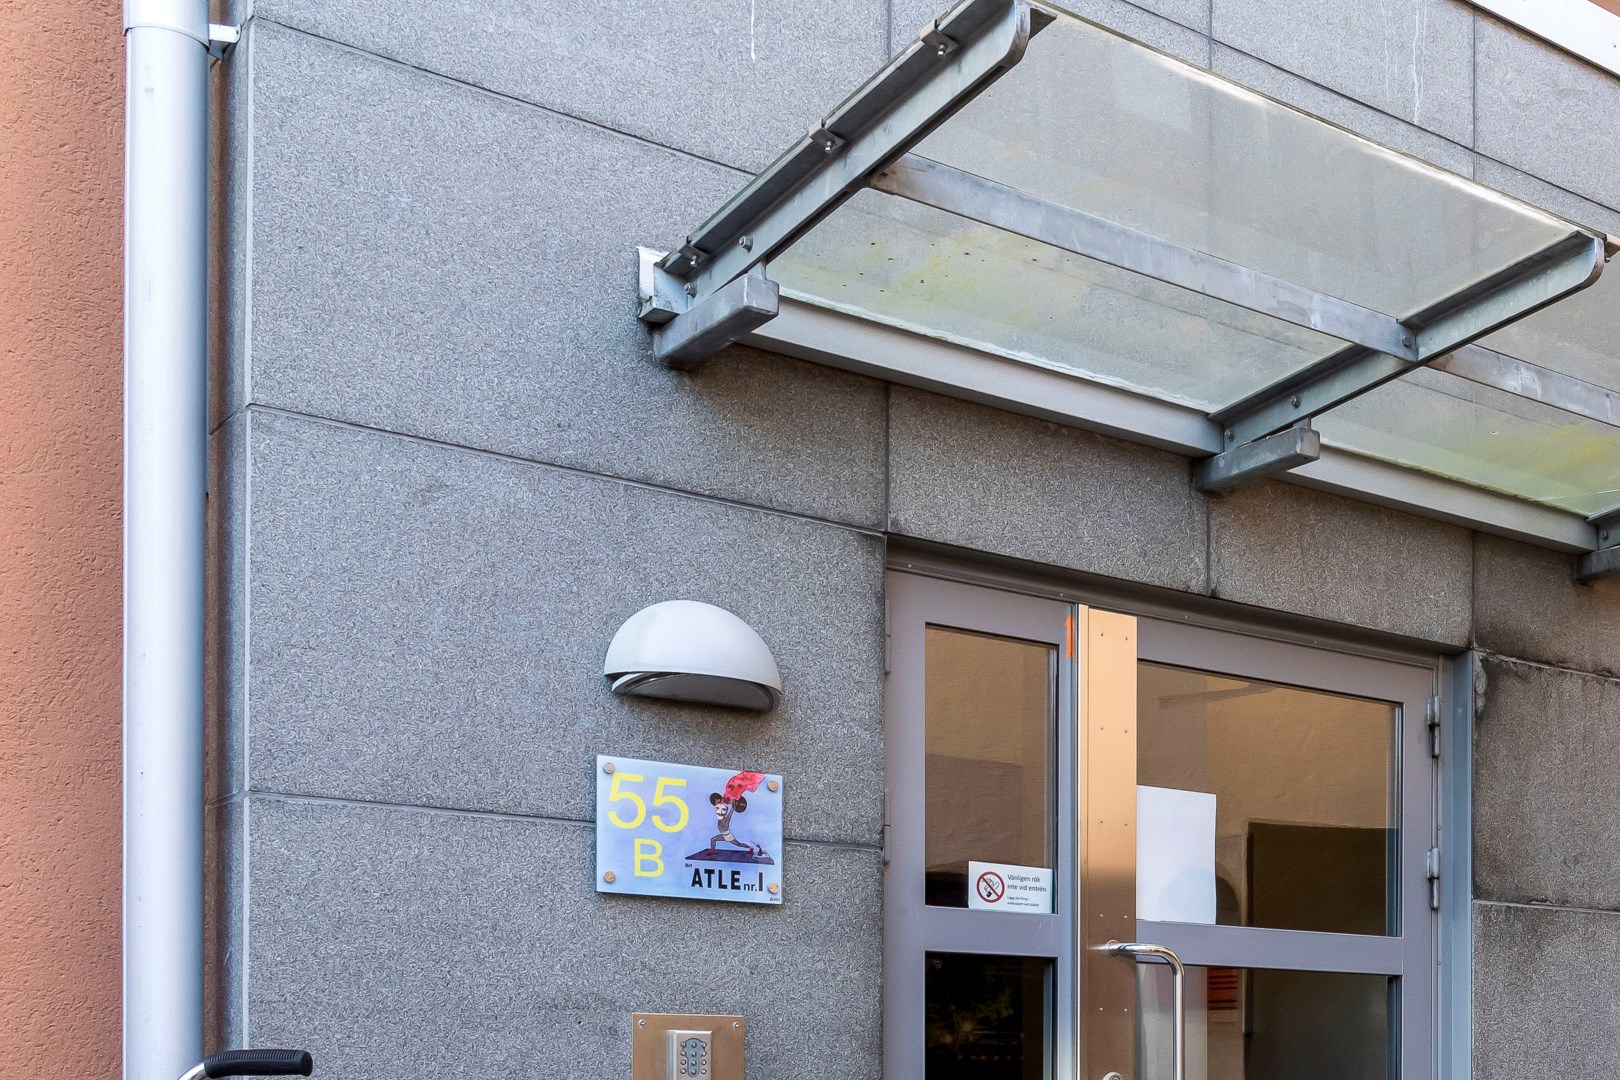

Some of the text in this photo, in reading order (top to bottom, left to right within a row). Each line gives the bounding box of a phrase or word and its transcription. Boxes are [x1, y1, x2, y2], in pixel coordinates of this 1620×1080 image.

[607, 772, 690, 833] 55
[633, 838, 665, 878] B
[690, 867, 742, 890] ATLE
[1007, 874, 1031, 882] Vänligen
